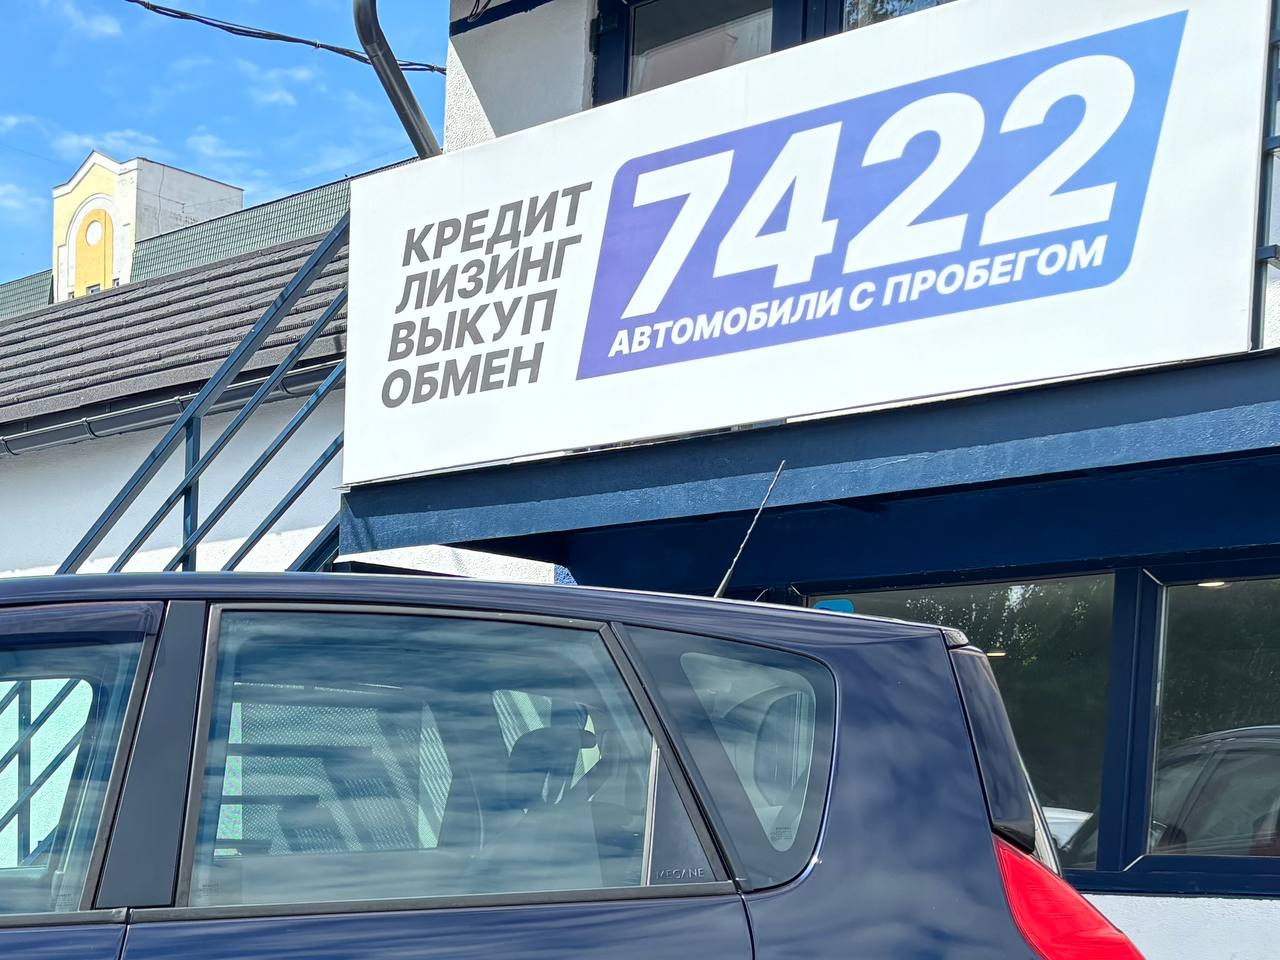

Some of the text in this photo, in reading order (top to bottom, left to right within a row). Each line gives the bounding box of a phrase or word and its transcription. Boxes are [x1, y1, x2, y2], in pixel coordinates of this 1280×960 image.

[402, 181, 593, 267] КРЕДИТ
[620, 54, 1136, 321] 7422
[395, 234, 582, 314] ЛИЗИНГ
[607, 234, 1109, 358] АВТОМОБИЛИ С ПРОБЕГОМ
[388, 288, 558, 362] ВЫКУП
[381, 341, 545, 409] ОБМЕН
[656, 867, 705, 880] MEGANE
